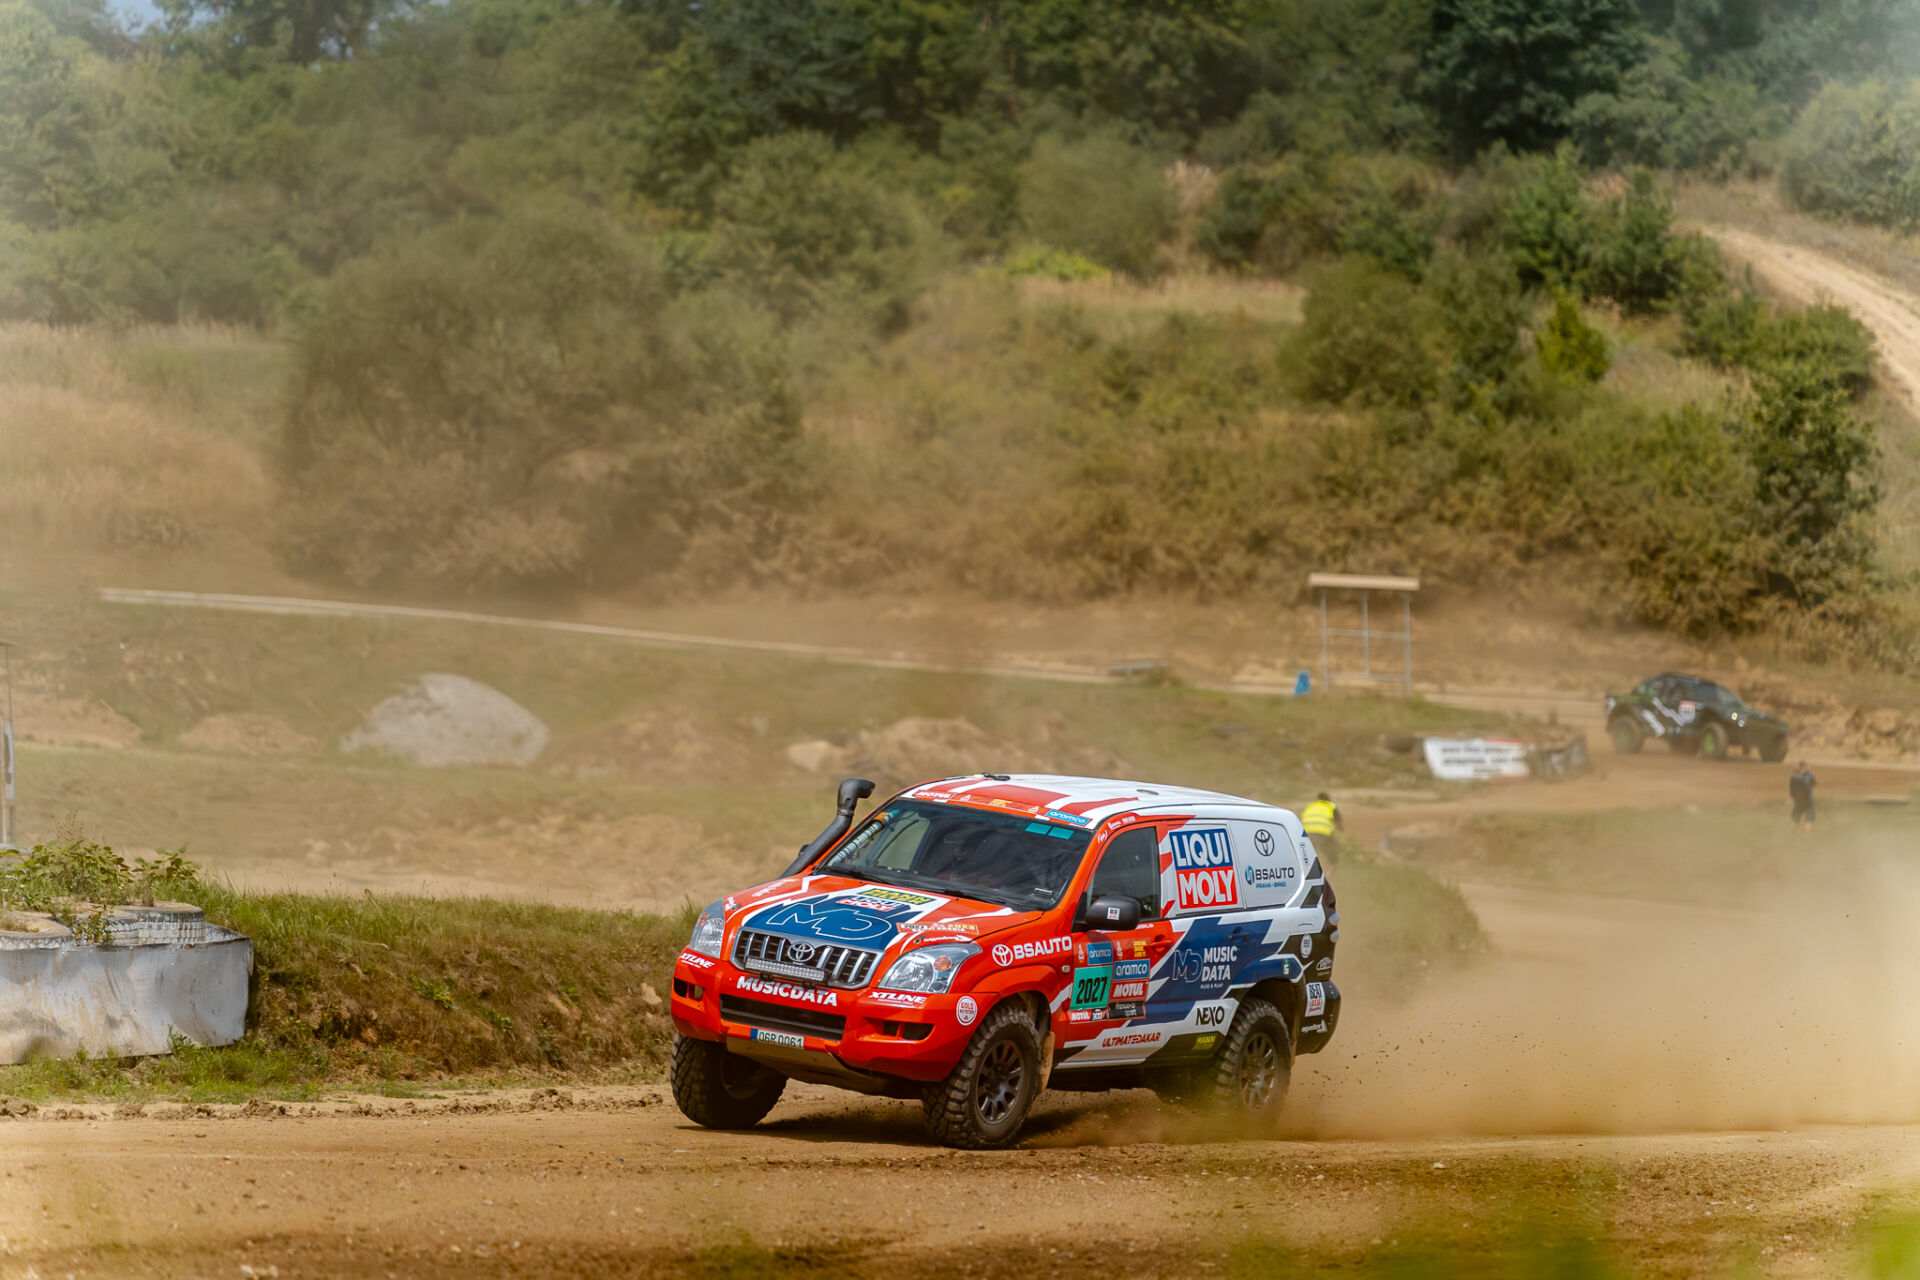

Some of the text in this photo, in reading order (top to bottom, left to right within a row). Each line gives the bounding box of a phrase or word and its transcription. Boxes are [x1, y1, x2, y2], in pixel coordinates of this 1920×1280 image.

[1050, 811, 1086, 824] aramco
[1173, 831, 1230, 868] LIQUI
[1255, 867, 1295, 880] BSAUTO
[1178, 869, 1235, 907] MOLY
[1013, 936, 1072, 960] BSAUTO
[1090, 949, 1112, 958] aramco
[1204, 946, 1238, 963] MUSIC
[1115, 963, 1148, 977] aramco
[1201, 964, 1231, 982] DATA
[736, 976, 838, 1007] MUSICDATA
[868, 991, 928, 1004] XTLINE
[1075, 976, 1109, 1005] 2027
[1113, 984, 1144, 998] MOTUL
[1071, 1011, 1090, 1021] MOTUL
[1195, 1005, 1226, 1027] NEXO
